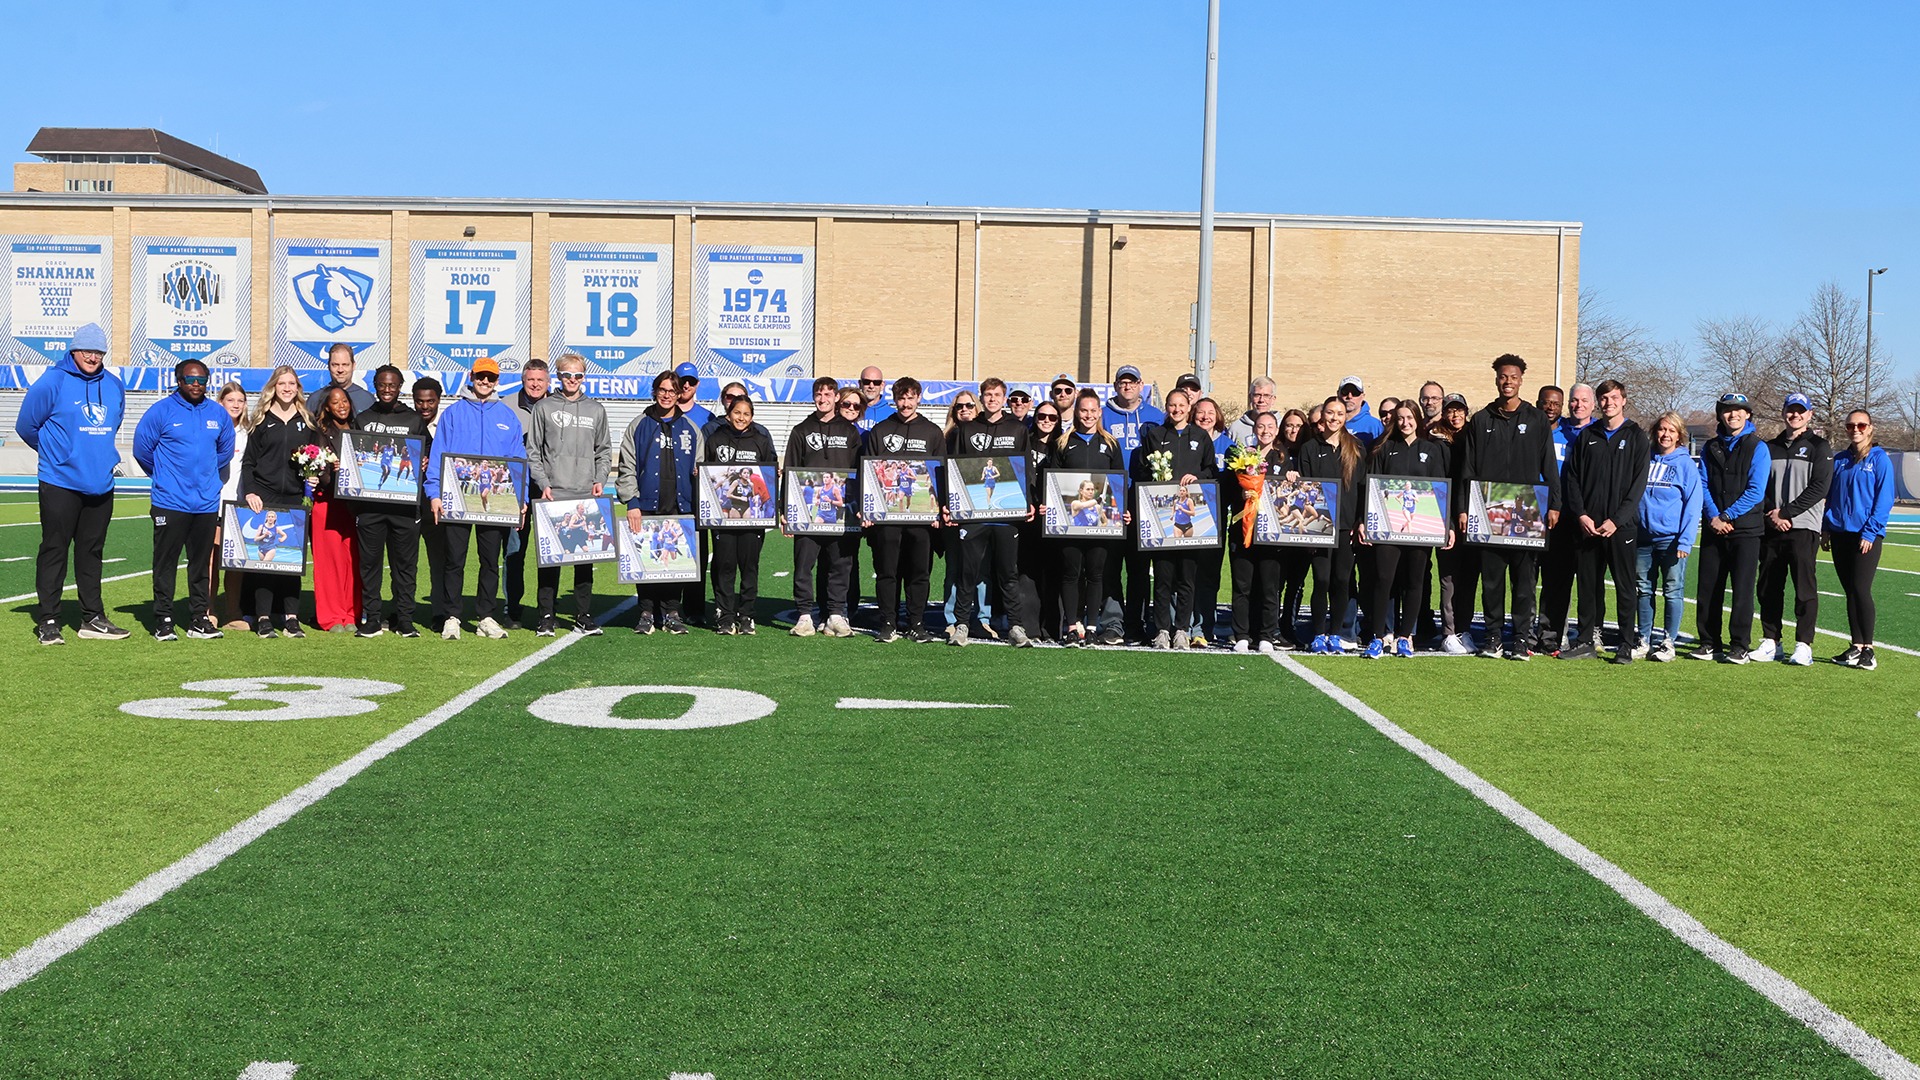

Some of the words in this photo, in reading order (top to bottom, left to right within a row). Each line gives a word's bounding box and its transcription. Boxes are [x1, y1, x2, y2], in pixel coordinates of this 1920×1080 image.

[170, 260, 192, 268] COACH
[17, 267, 94, 279] SHANAHAN
[451, 273, 490, 285] ROMO
[584, 275, 639, 287] PAYTON
[39, 287, 72, 296] XXXIII
[41, 297, 70, 306] XXXII
[723, 288, 787, 312] 1974
[43, 308, 68, 316] XXIX
[445, 290, 496, 334] 17
[586, 292, 638, 337] 18
[720, 314, 751, 323] TRACK
[173, 325, 208, 337] SPOO
[44, 342, 66, 350] 1978
[729, 338, 770, 346] DIVISION
[170, 343, 181, 352] 25
[183, 343, 211, 352] YEARS
[450, 348, 488, 357] 10.17.09
[742, 354, 766, 363] 1974
[164, 372, 242, 387] ILOIS
[550, 378, 638, 395] ETERN
[340, 468, 350, 477] 20
[339, 478, 350, 486] 26
[442, 492, 453, 500] 20
[864, 494, 874, 502] 20
[949, 493, 960, 501] 20
[442, 501, 453, 510] 26
[950, 502, 960, 510] 26
[1258, 514, 1268, 522] 20
[1368, 512, 1378, 521] 20
[1469, 515, 1479, 523] 20
[1258, 524, 1268, 532] 26
[1367, 522, 1378, 530] 26
[1469, 524, 1478, 533] 26
[224, 540, 235, 548] 20
[540, 537, 550, 546] 20
[224, 549, 234, 557] 26
[541, 546, 551, 555] 26
